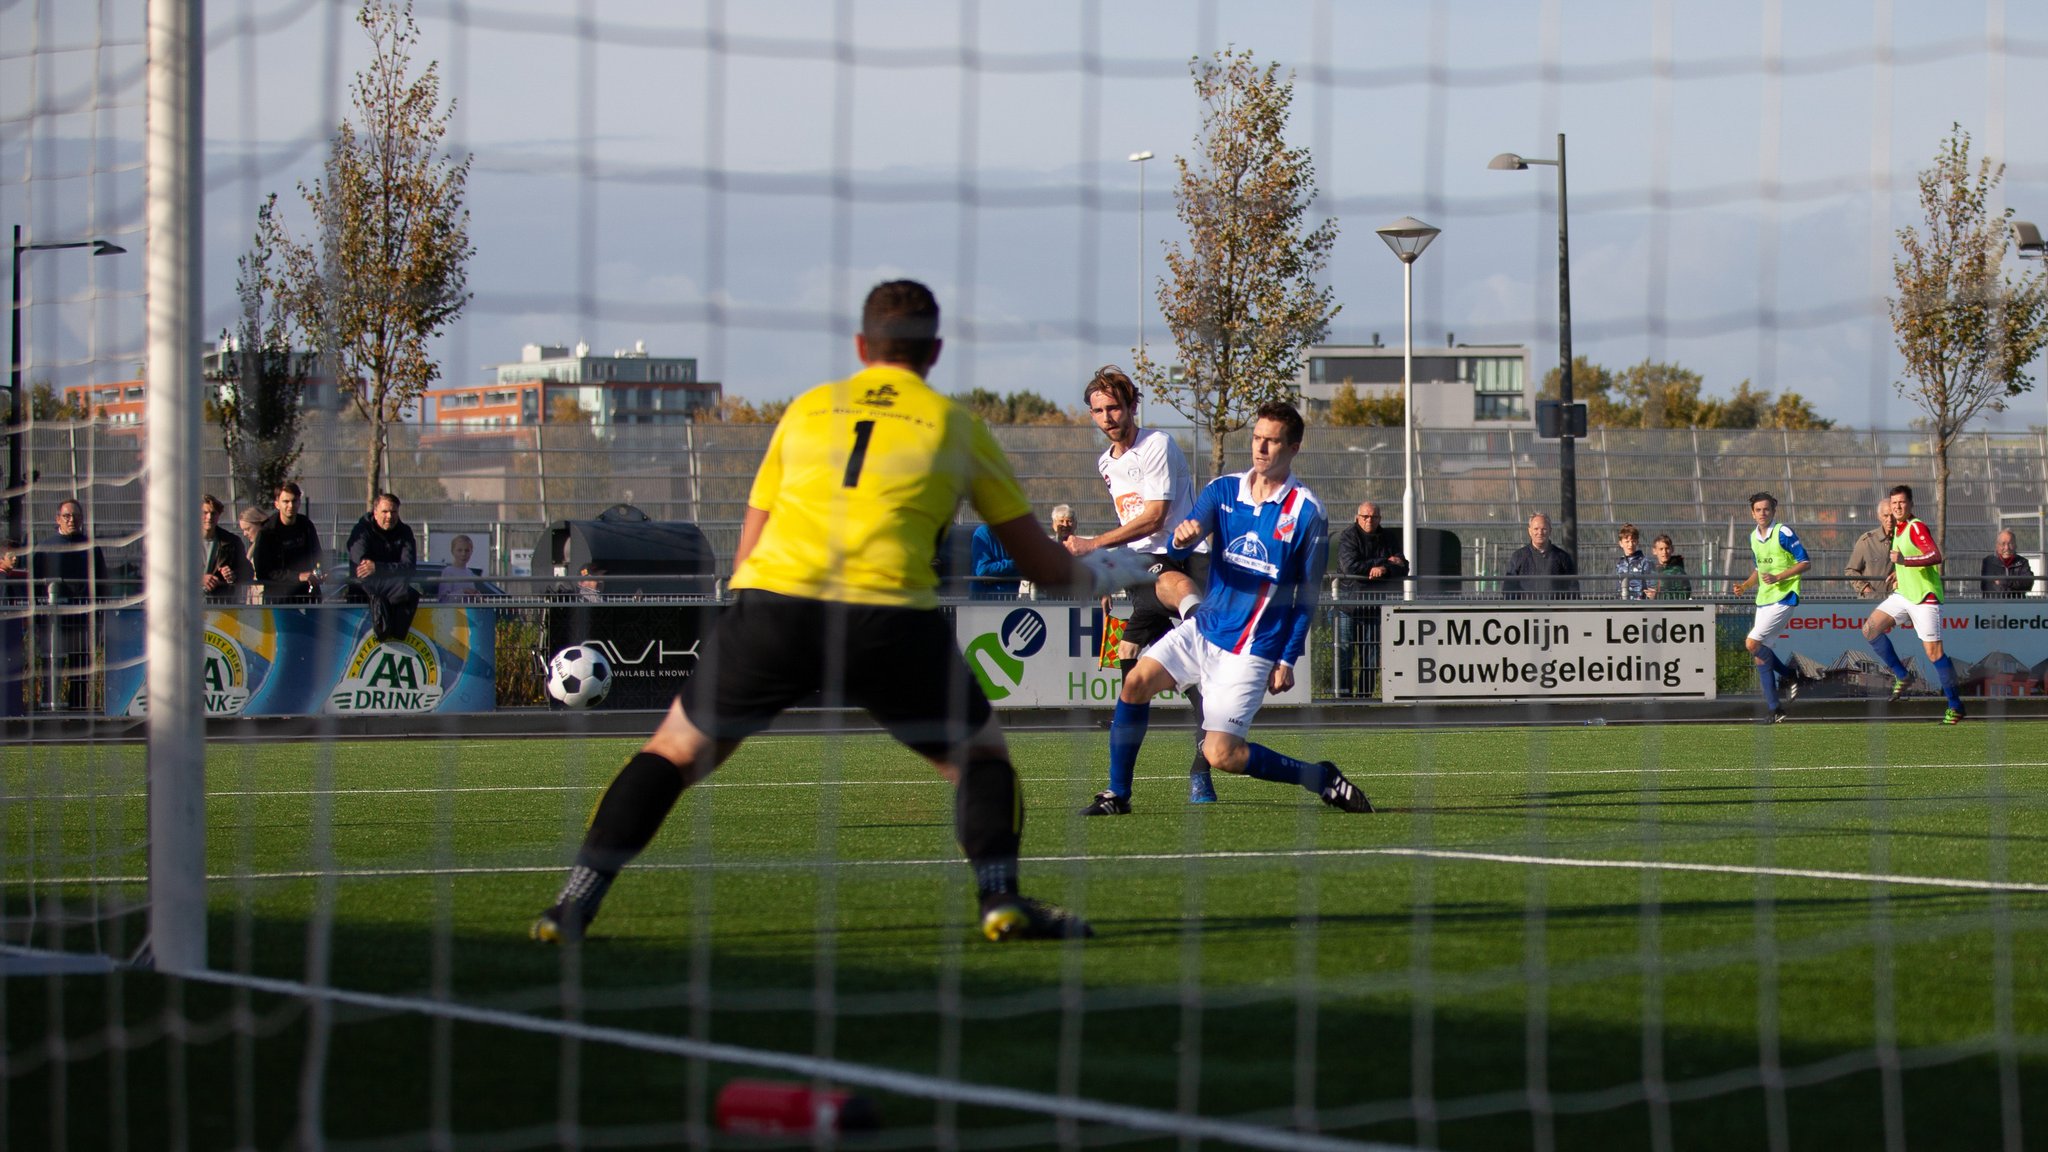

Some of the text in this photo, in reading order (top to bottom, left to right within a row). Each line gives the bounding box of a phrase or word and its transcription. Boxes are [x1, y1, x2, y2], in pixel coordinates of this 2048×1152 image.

[842, 420, 876, 488] 1
[1393, 617, 1569, 651] J.P.M.Colijn
[1606, 617, 1705, 644] Leiden
[204, 657, 224, 692] A
[366, 652, 419, 690] AA
[1417, 655, 1681, 688] Bouwbegeleiding
[354, 690, 425, 710] DRINK
